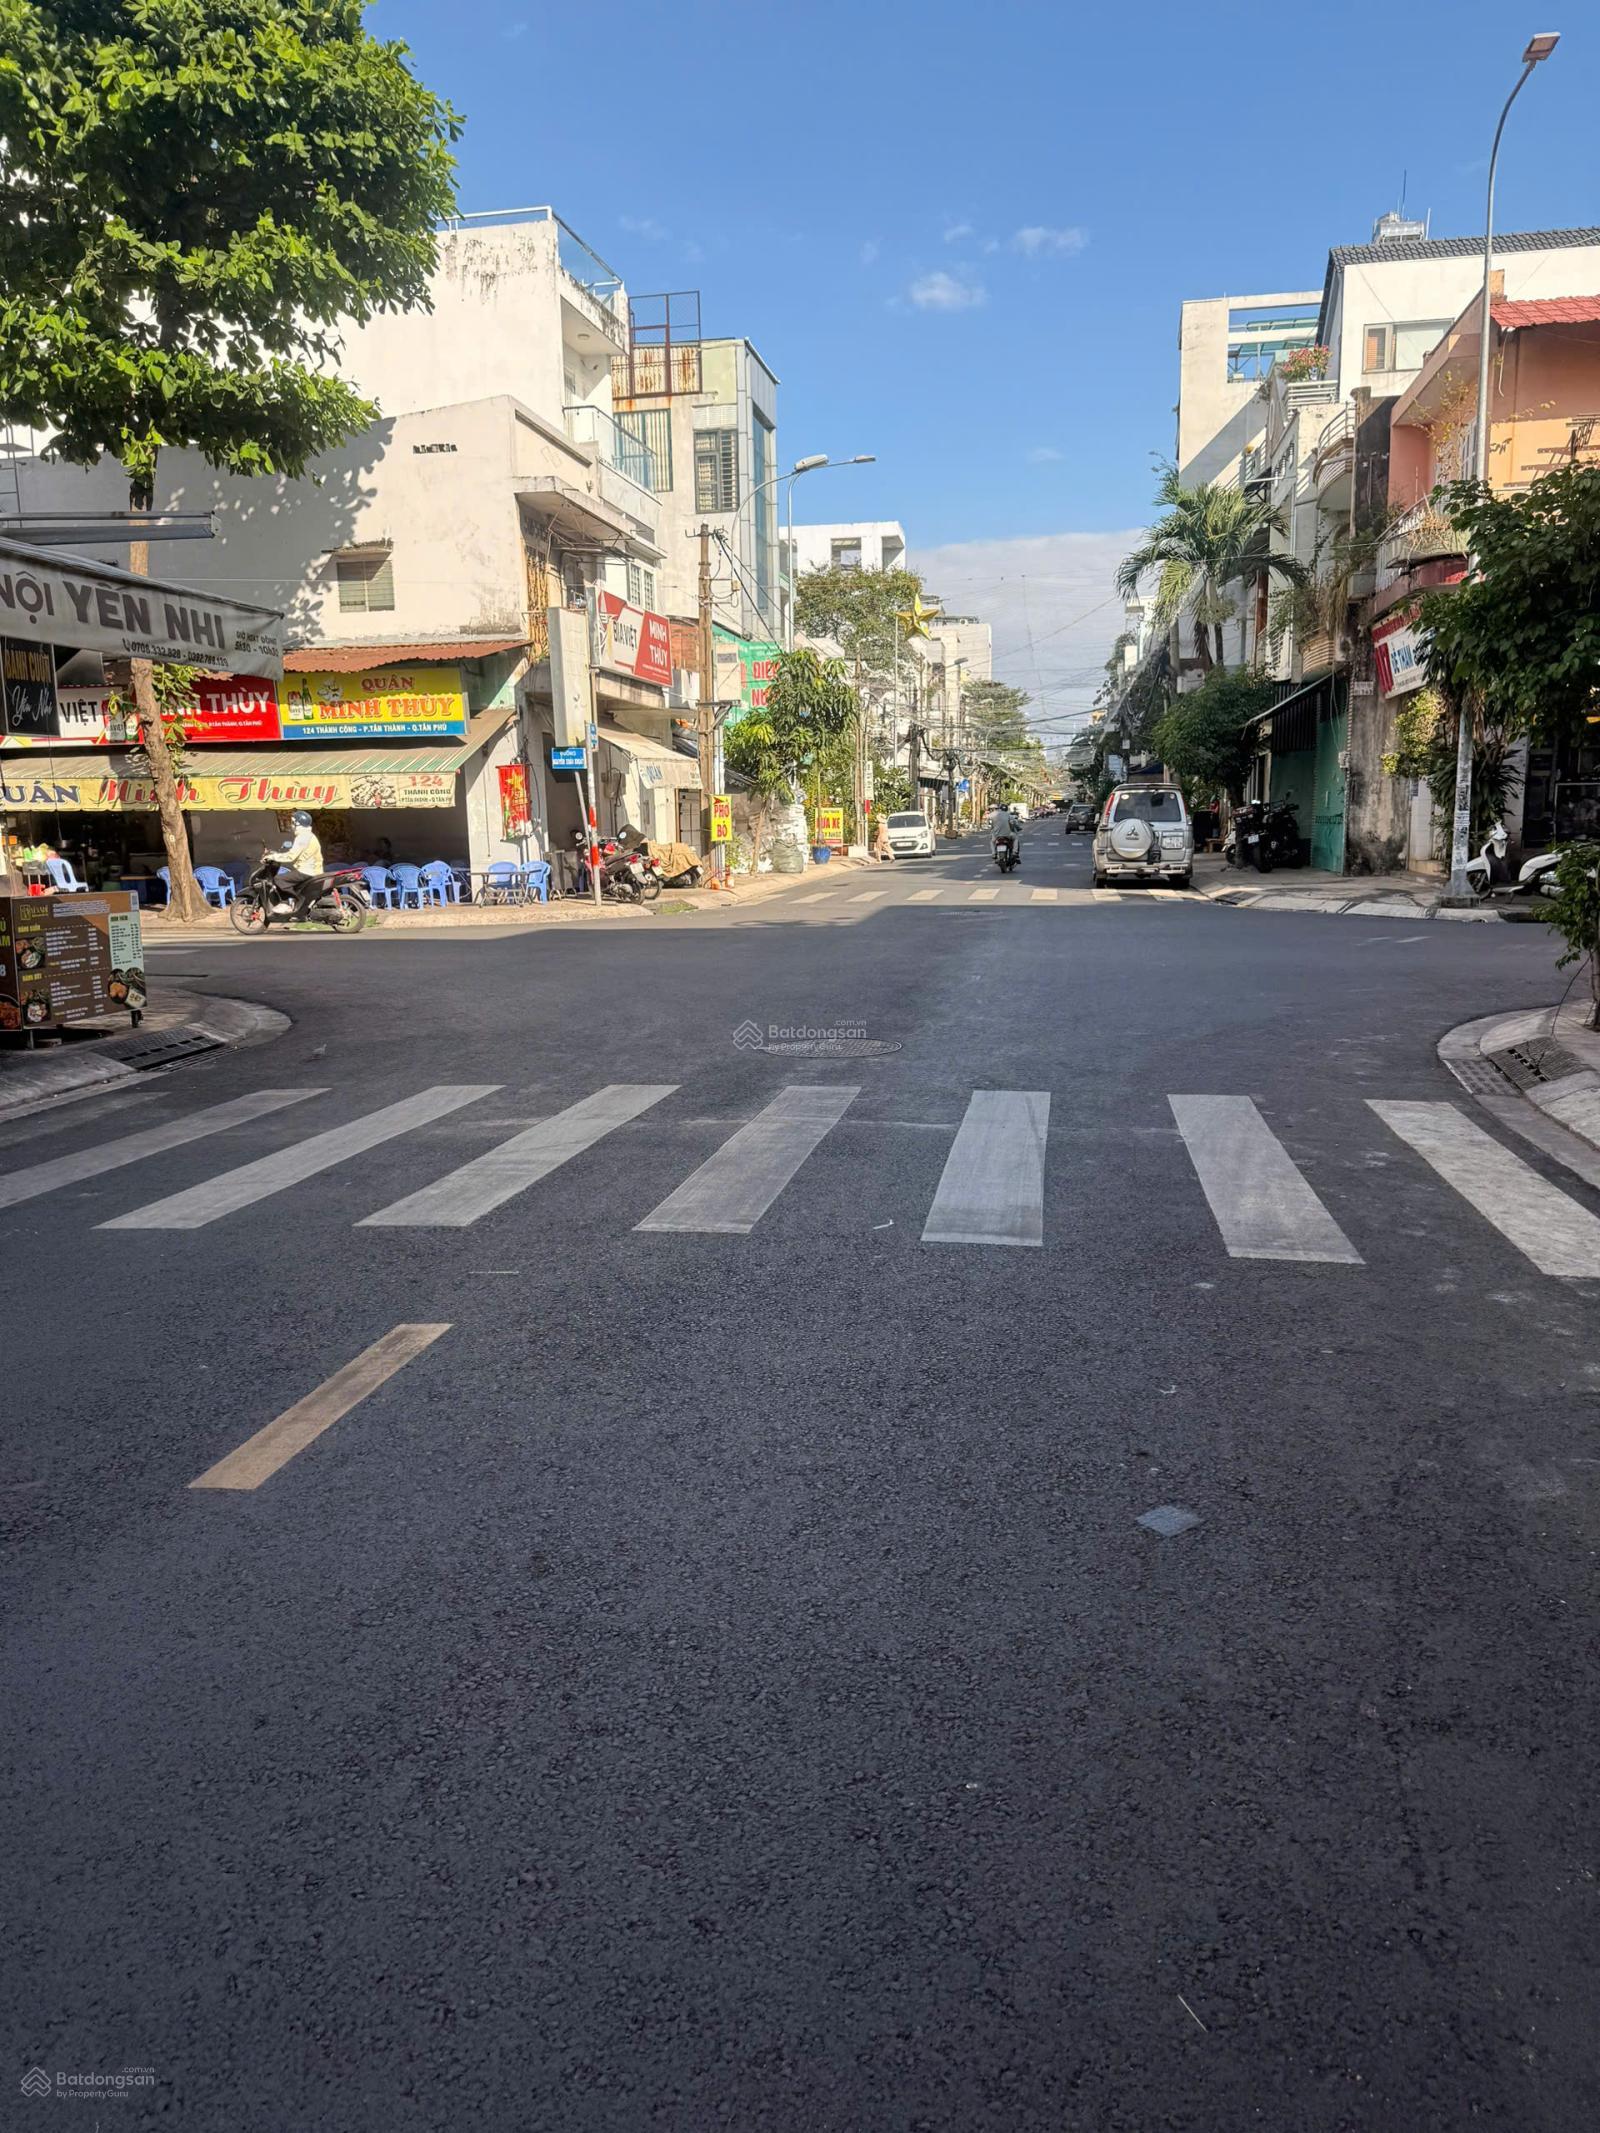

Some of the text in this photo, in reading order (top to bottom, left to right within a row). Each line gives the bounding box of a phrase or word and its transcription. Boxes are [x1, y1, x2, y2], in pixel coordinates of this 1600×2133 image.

[63, 581, 151, 634] YẾN
[164, 602, 226, 649] NHI
[649, 619, 667, 643] MINH
[60, 699, 98, 726] VIỆT
[206, 687, 270, 714] THÙY
[318, 699, 381, 720] MINH
[302, 727, 314, 735] 124
[316, 725, 338, 734] THÀNH
[338, 724, 358, 733] CÔNG
[383, 723, 405, 732] THÀNH
[218, 776, 343, 807] Thùy
[407, 775, 443, 787] 124
